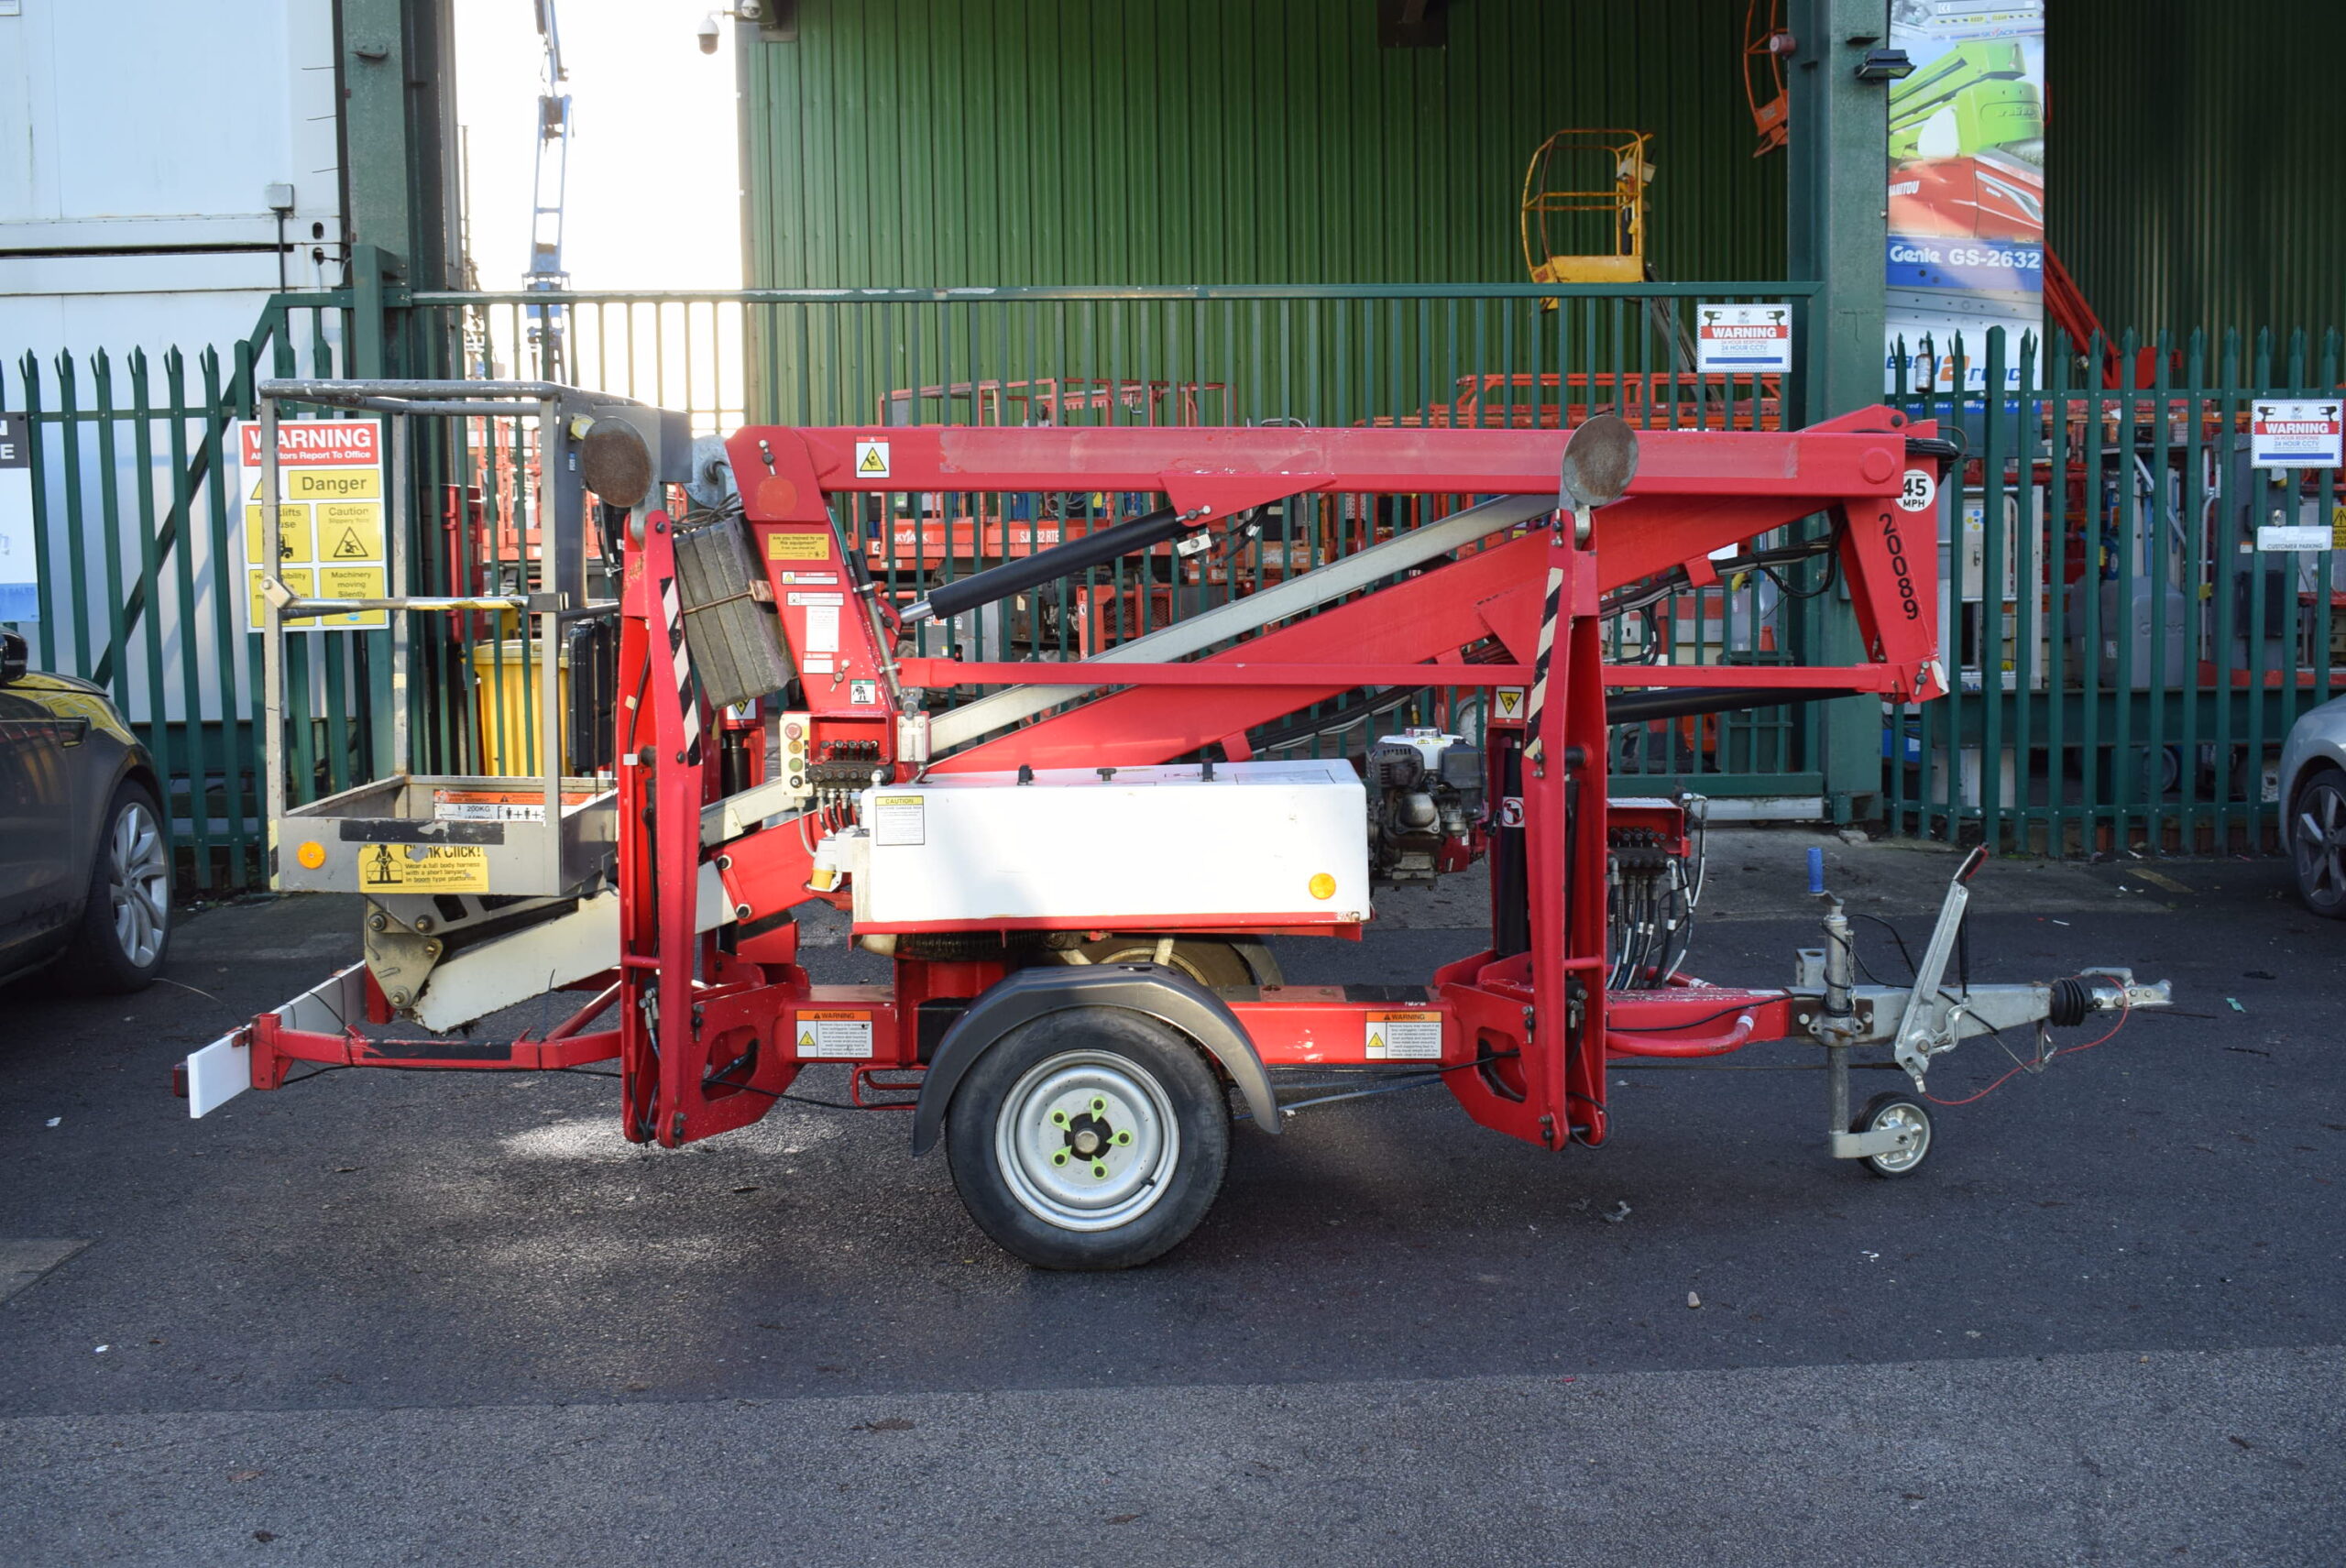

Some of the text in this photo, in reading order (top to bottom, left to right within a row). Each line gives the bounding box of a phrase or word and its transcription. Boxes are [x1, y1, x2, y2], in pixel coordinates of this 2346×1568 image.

[1890, 244, 2041, 269] Genie GS-2632
[1711, 327, 1777, 338] WARNING
[2265, 422, 2329, 434] WARNING
[300, 451, 330, 461] Report
[332, 451, 344, 459] To
[345, 450, 371, 459] Office
[301, 476, 367, 494] Danger
[1903, 478, 1926, 497] 45
[1903, 499, 1925, 508] MPH
[1879, 513, 1919, 620] 20089
[331, 571, 371, 579] Machinery
[338, 590, 367, 598] Silently
[403, 843, 441, 859] Cnk
